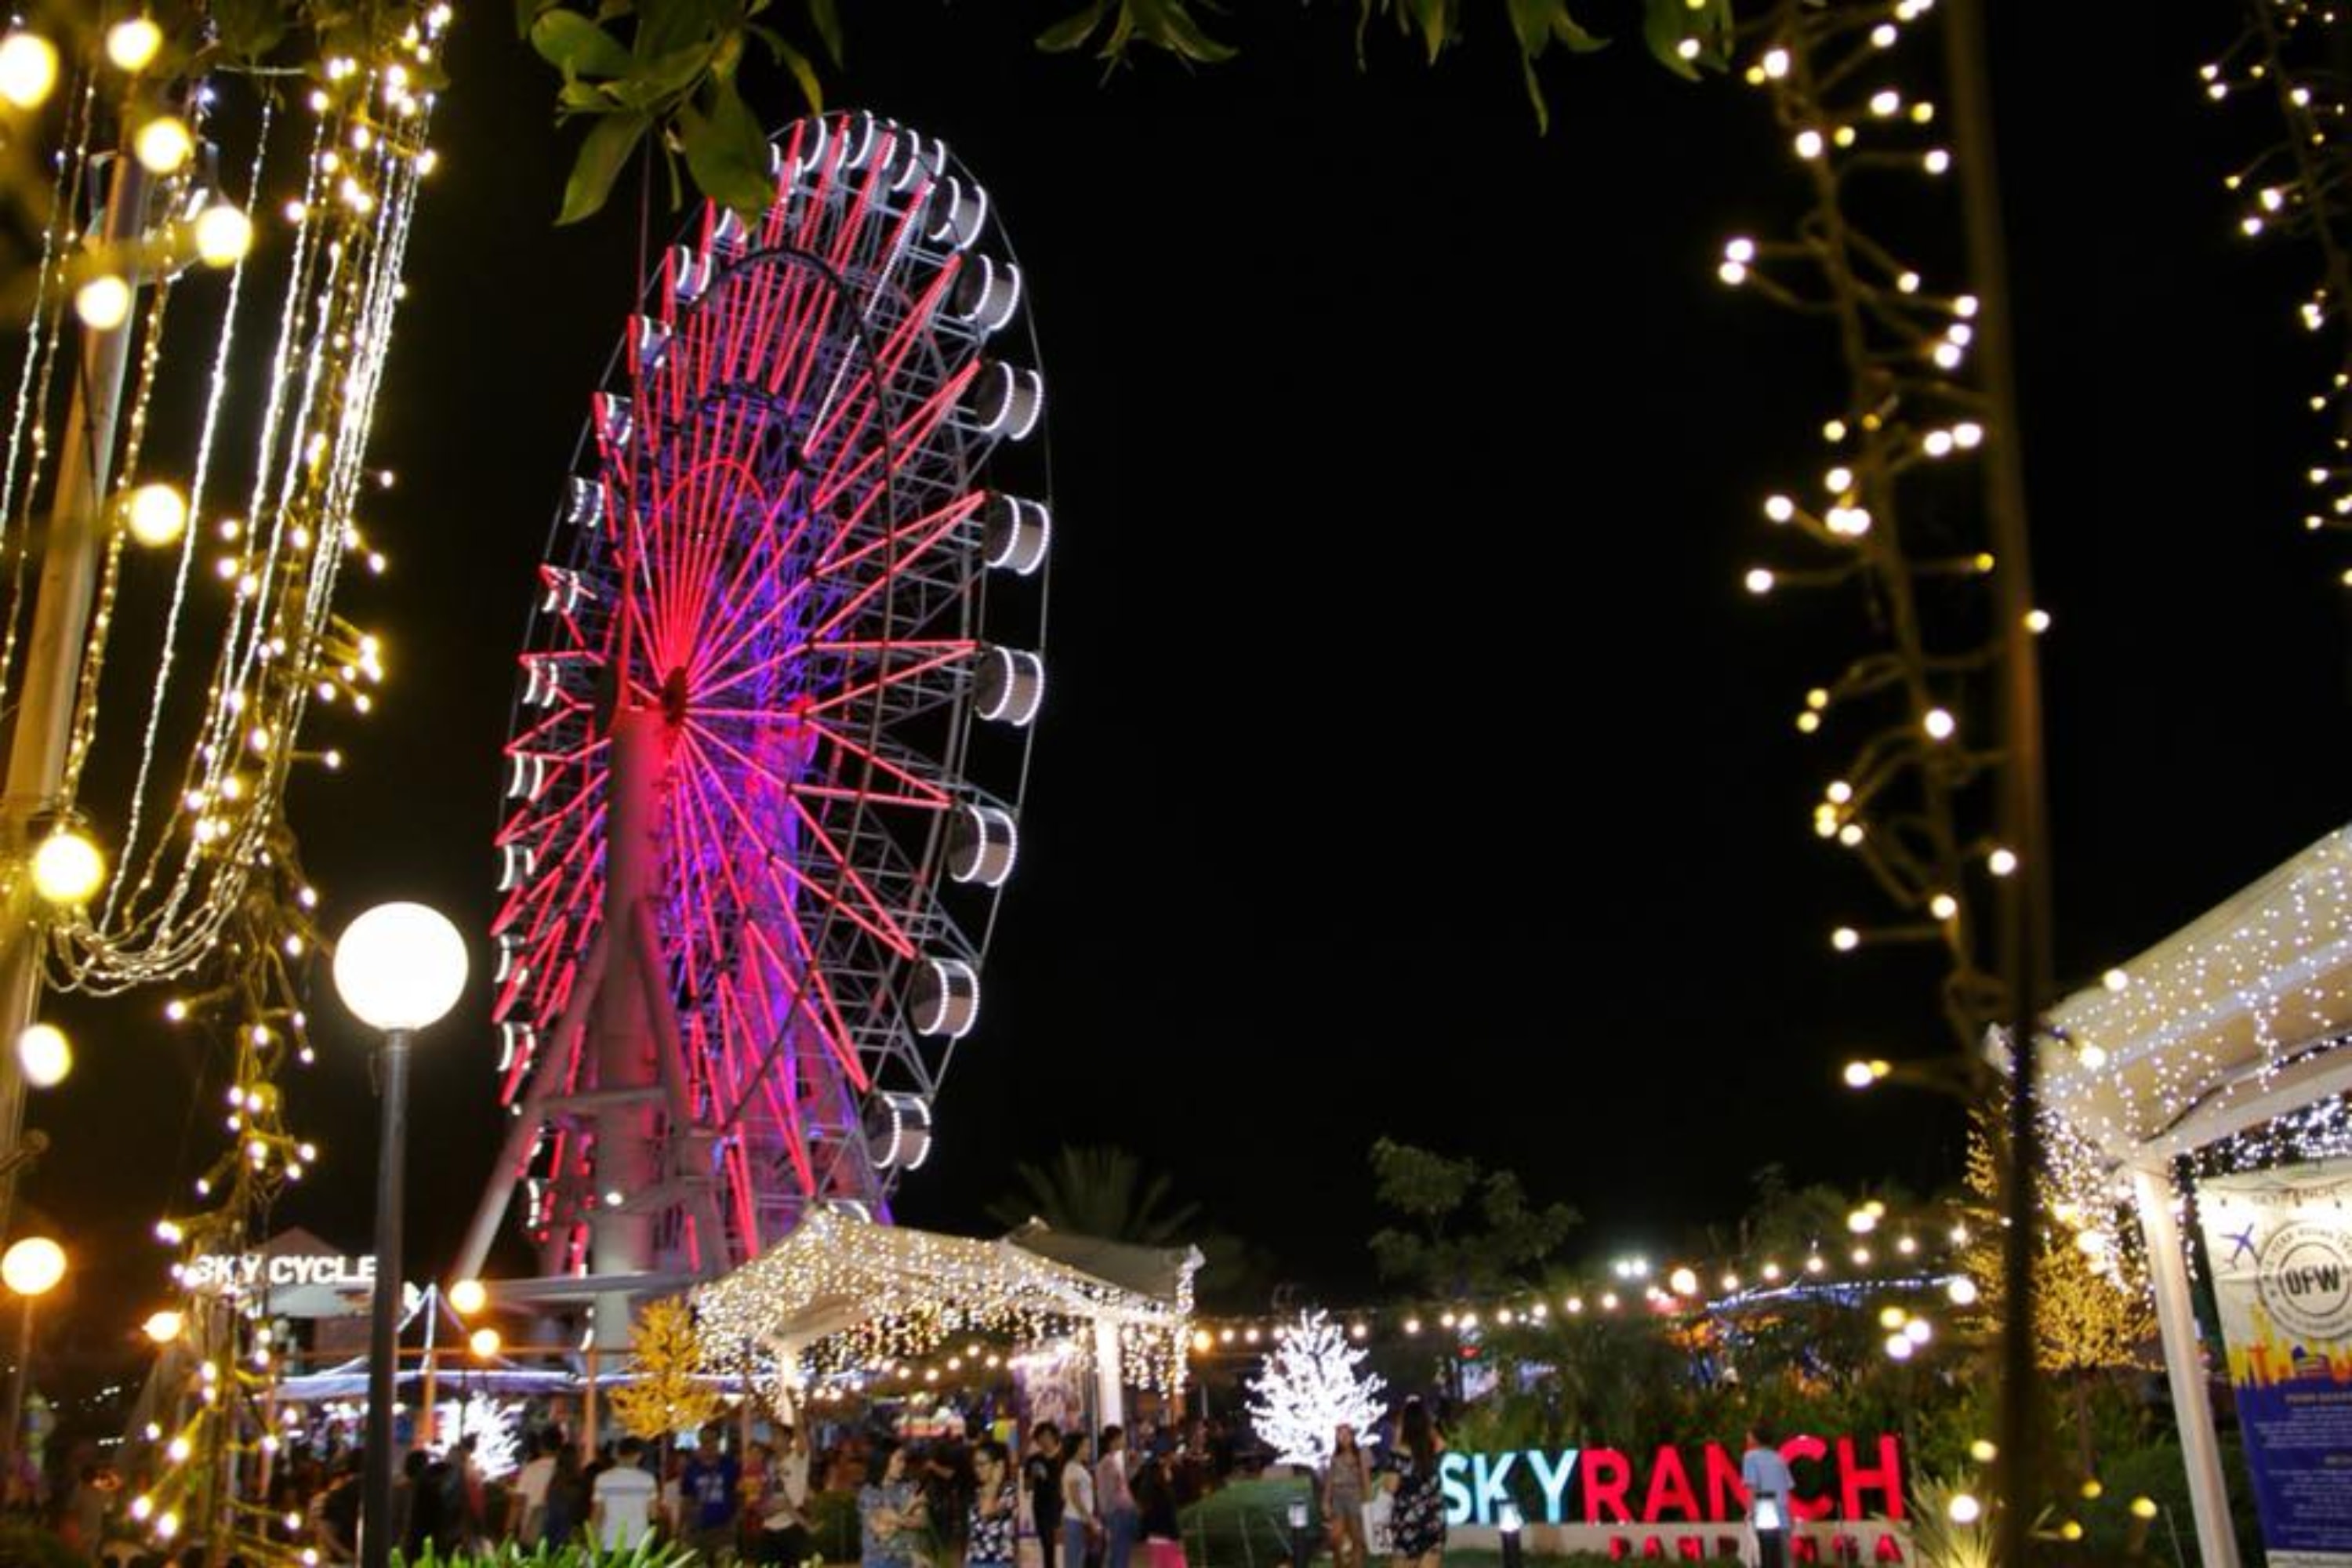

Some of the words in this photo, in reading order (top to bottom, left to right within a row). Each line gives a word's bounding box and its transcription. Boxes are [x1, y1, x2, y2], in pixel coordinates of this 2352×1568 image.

[195, 1255, 262, 1284] SKY
[269, 1255, 377, 1284] CYCLE
[2285, 1264, 2341, 1296] OFW
